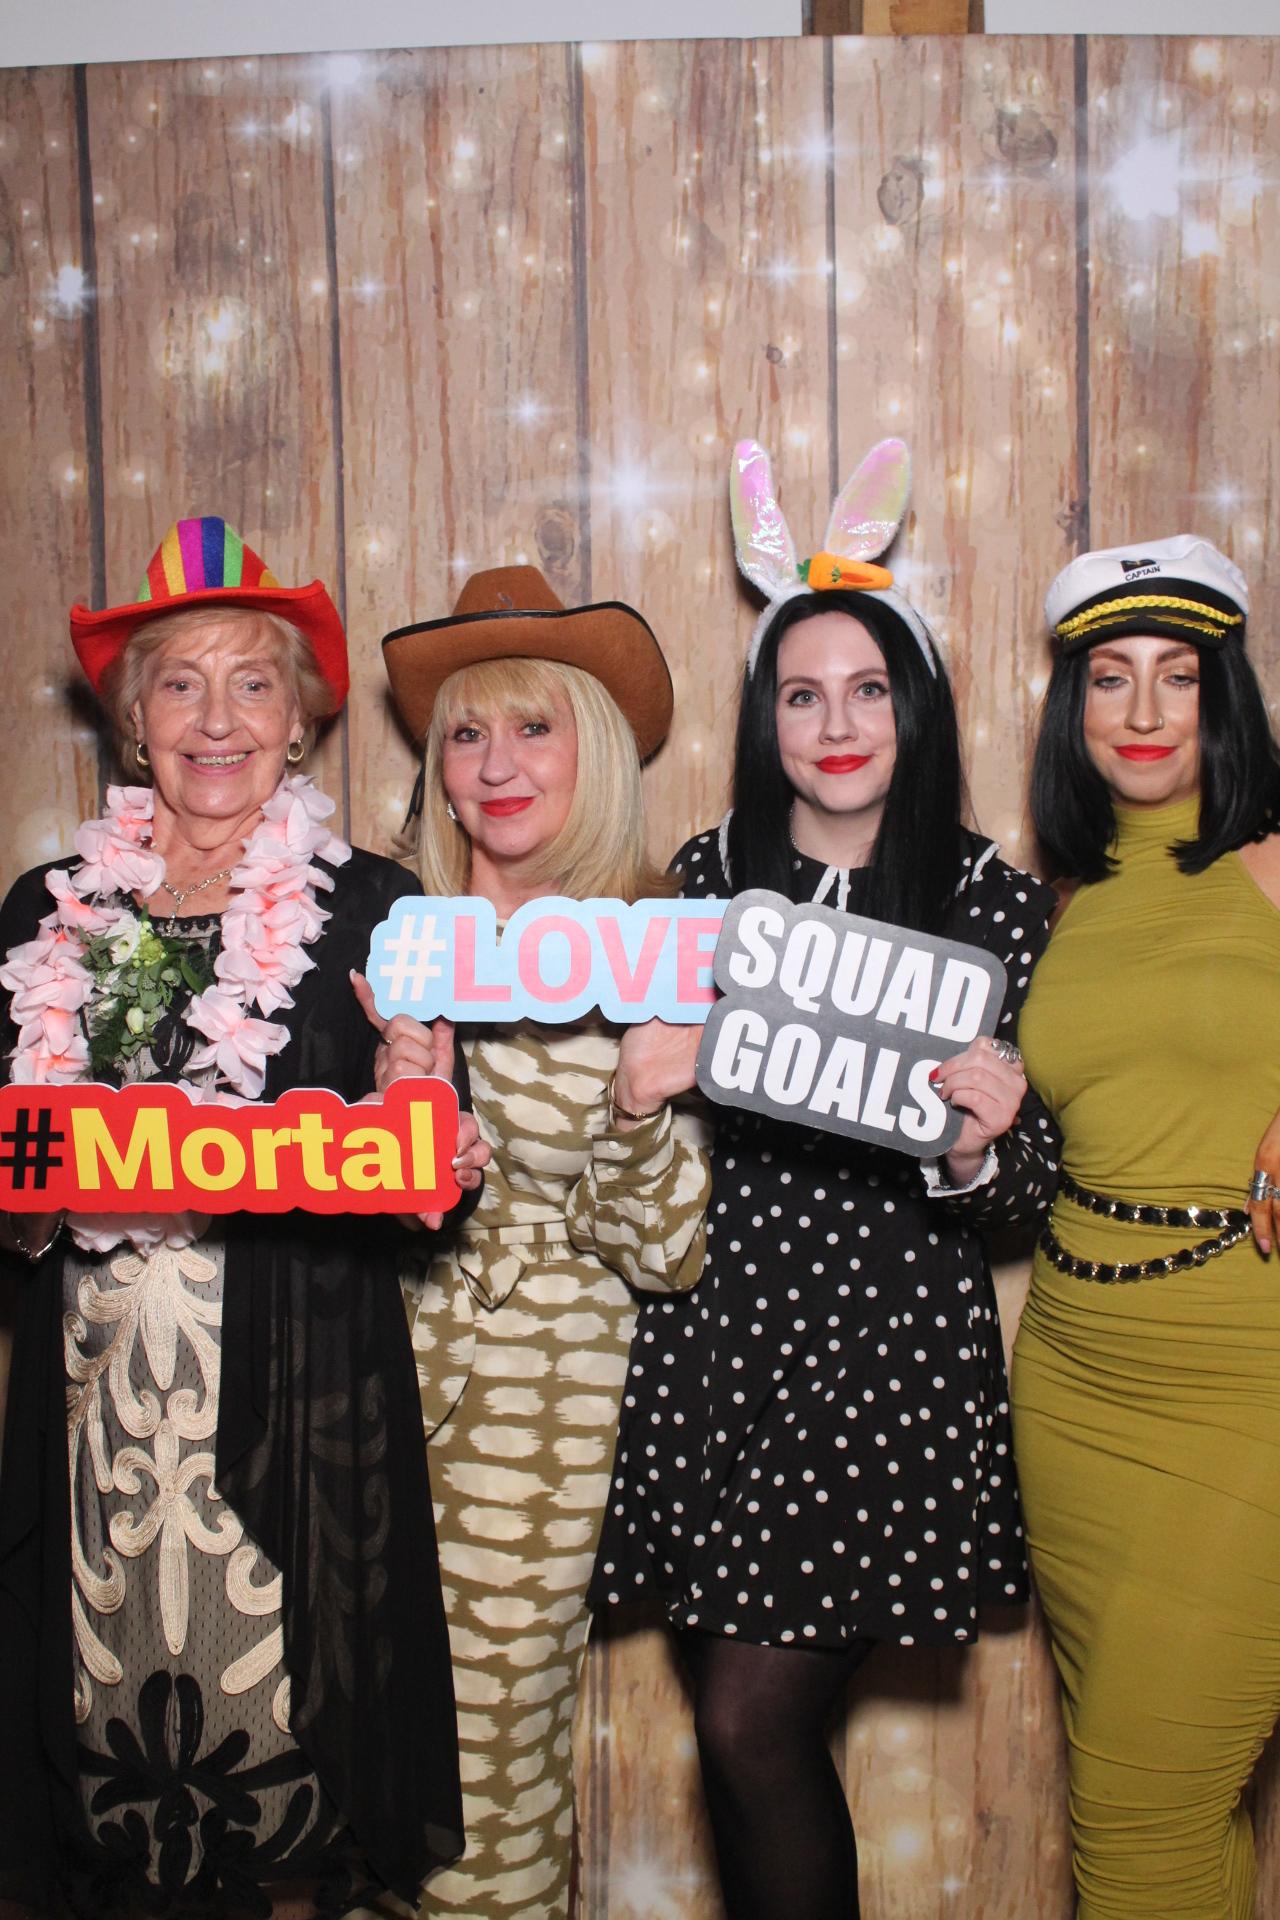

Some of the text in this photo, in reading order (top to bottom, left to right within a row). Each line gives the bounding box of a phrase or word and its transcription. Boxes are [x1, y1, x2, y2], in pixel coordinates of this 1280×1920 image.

[1125, 565, 1161, 582] CAPTAIN
[379, 914, 724, 1004] #LOVE
[728, 905, 991, 1043] SQUAD
[710, 1009, 947, 1142] GOALS
[0, 1101, 437, 1192] #Mortal
